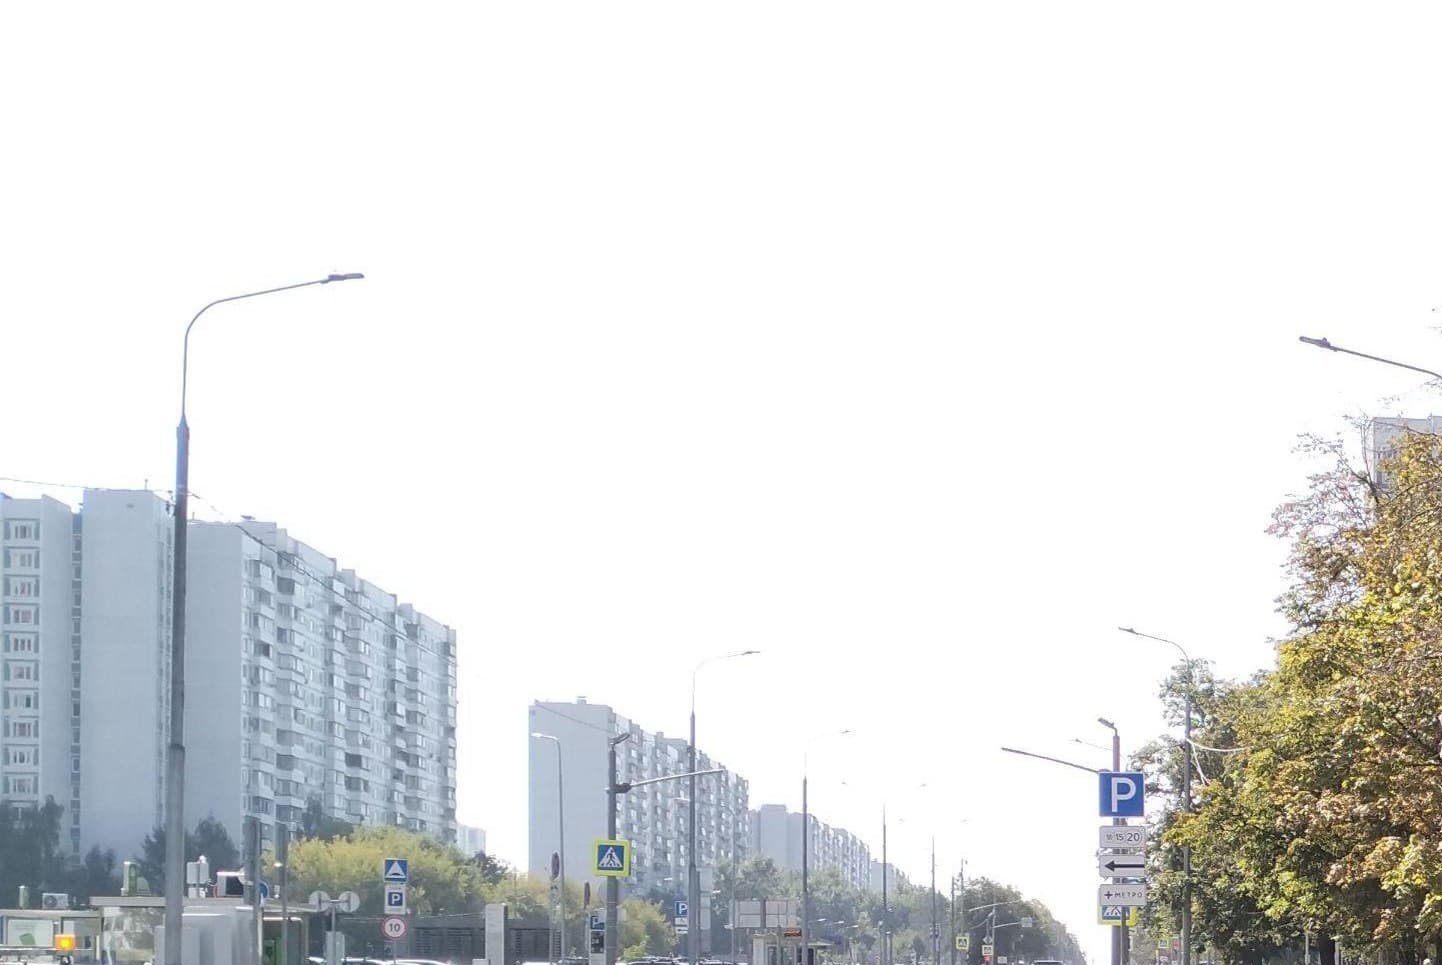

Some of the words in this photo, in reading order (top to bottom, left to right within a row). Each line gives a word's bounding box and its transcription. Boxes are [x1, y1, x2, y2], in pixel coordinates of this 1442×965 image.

[1111, 777, 1136, 812] P
[1127, 832, 1140, 842] 20
[388, 923, 401, 932] 10
